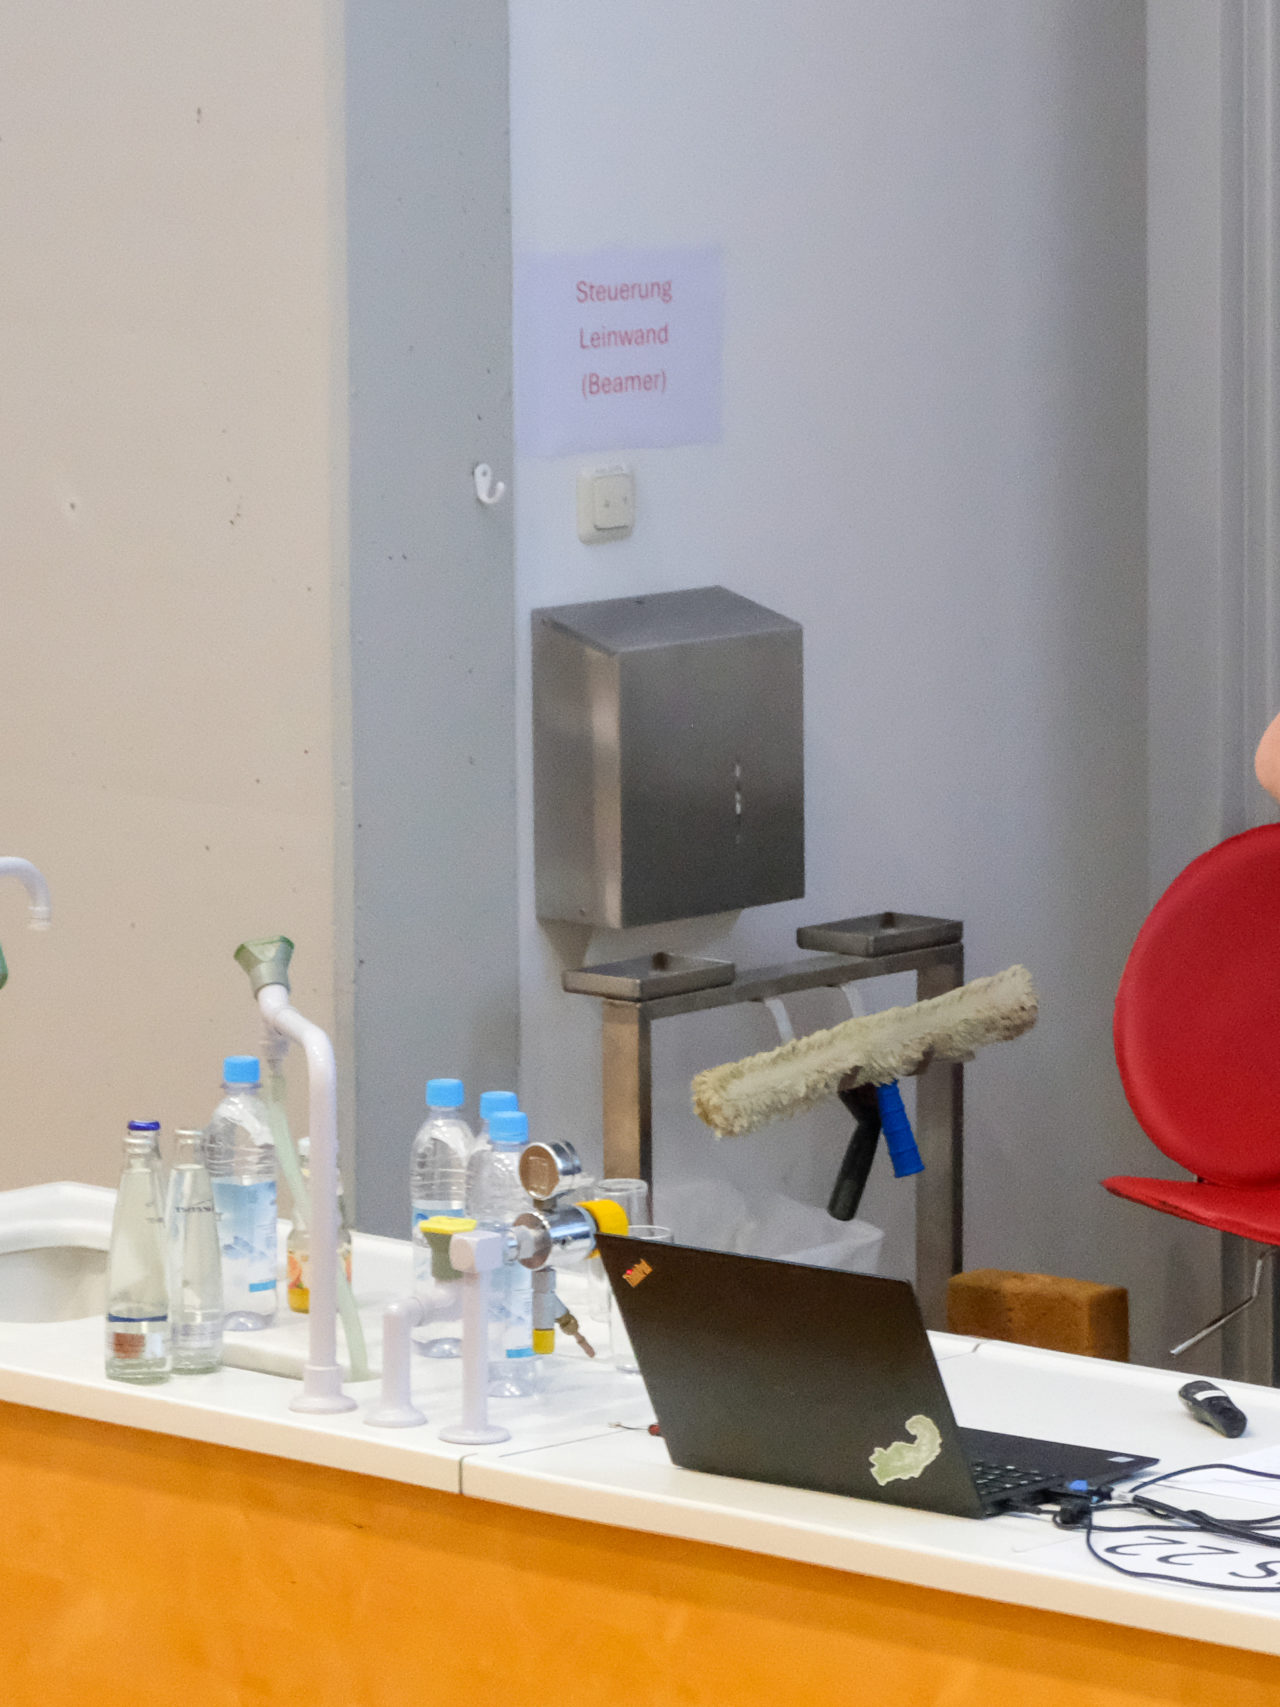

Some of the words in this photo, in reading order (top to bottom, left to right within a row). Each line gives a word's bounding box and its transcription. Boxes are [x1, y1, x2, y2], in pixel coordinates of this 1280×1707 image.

[576, 279, 673, 304] Steuerung
[579, 323, 669, 350] Leinwand
[582, 370, 667, 400] (Beamer)
[1104, 1535, 1240, 1566] 22
